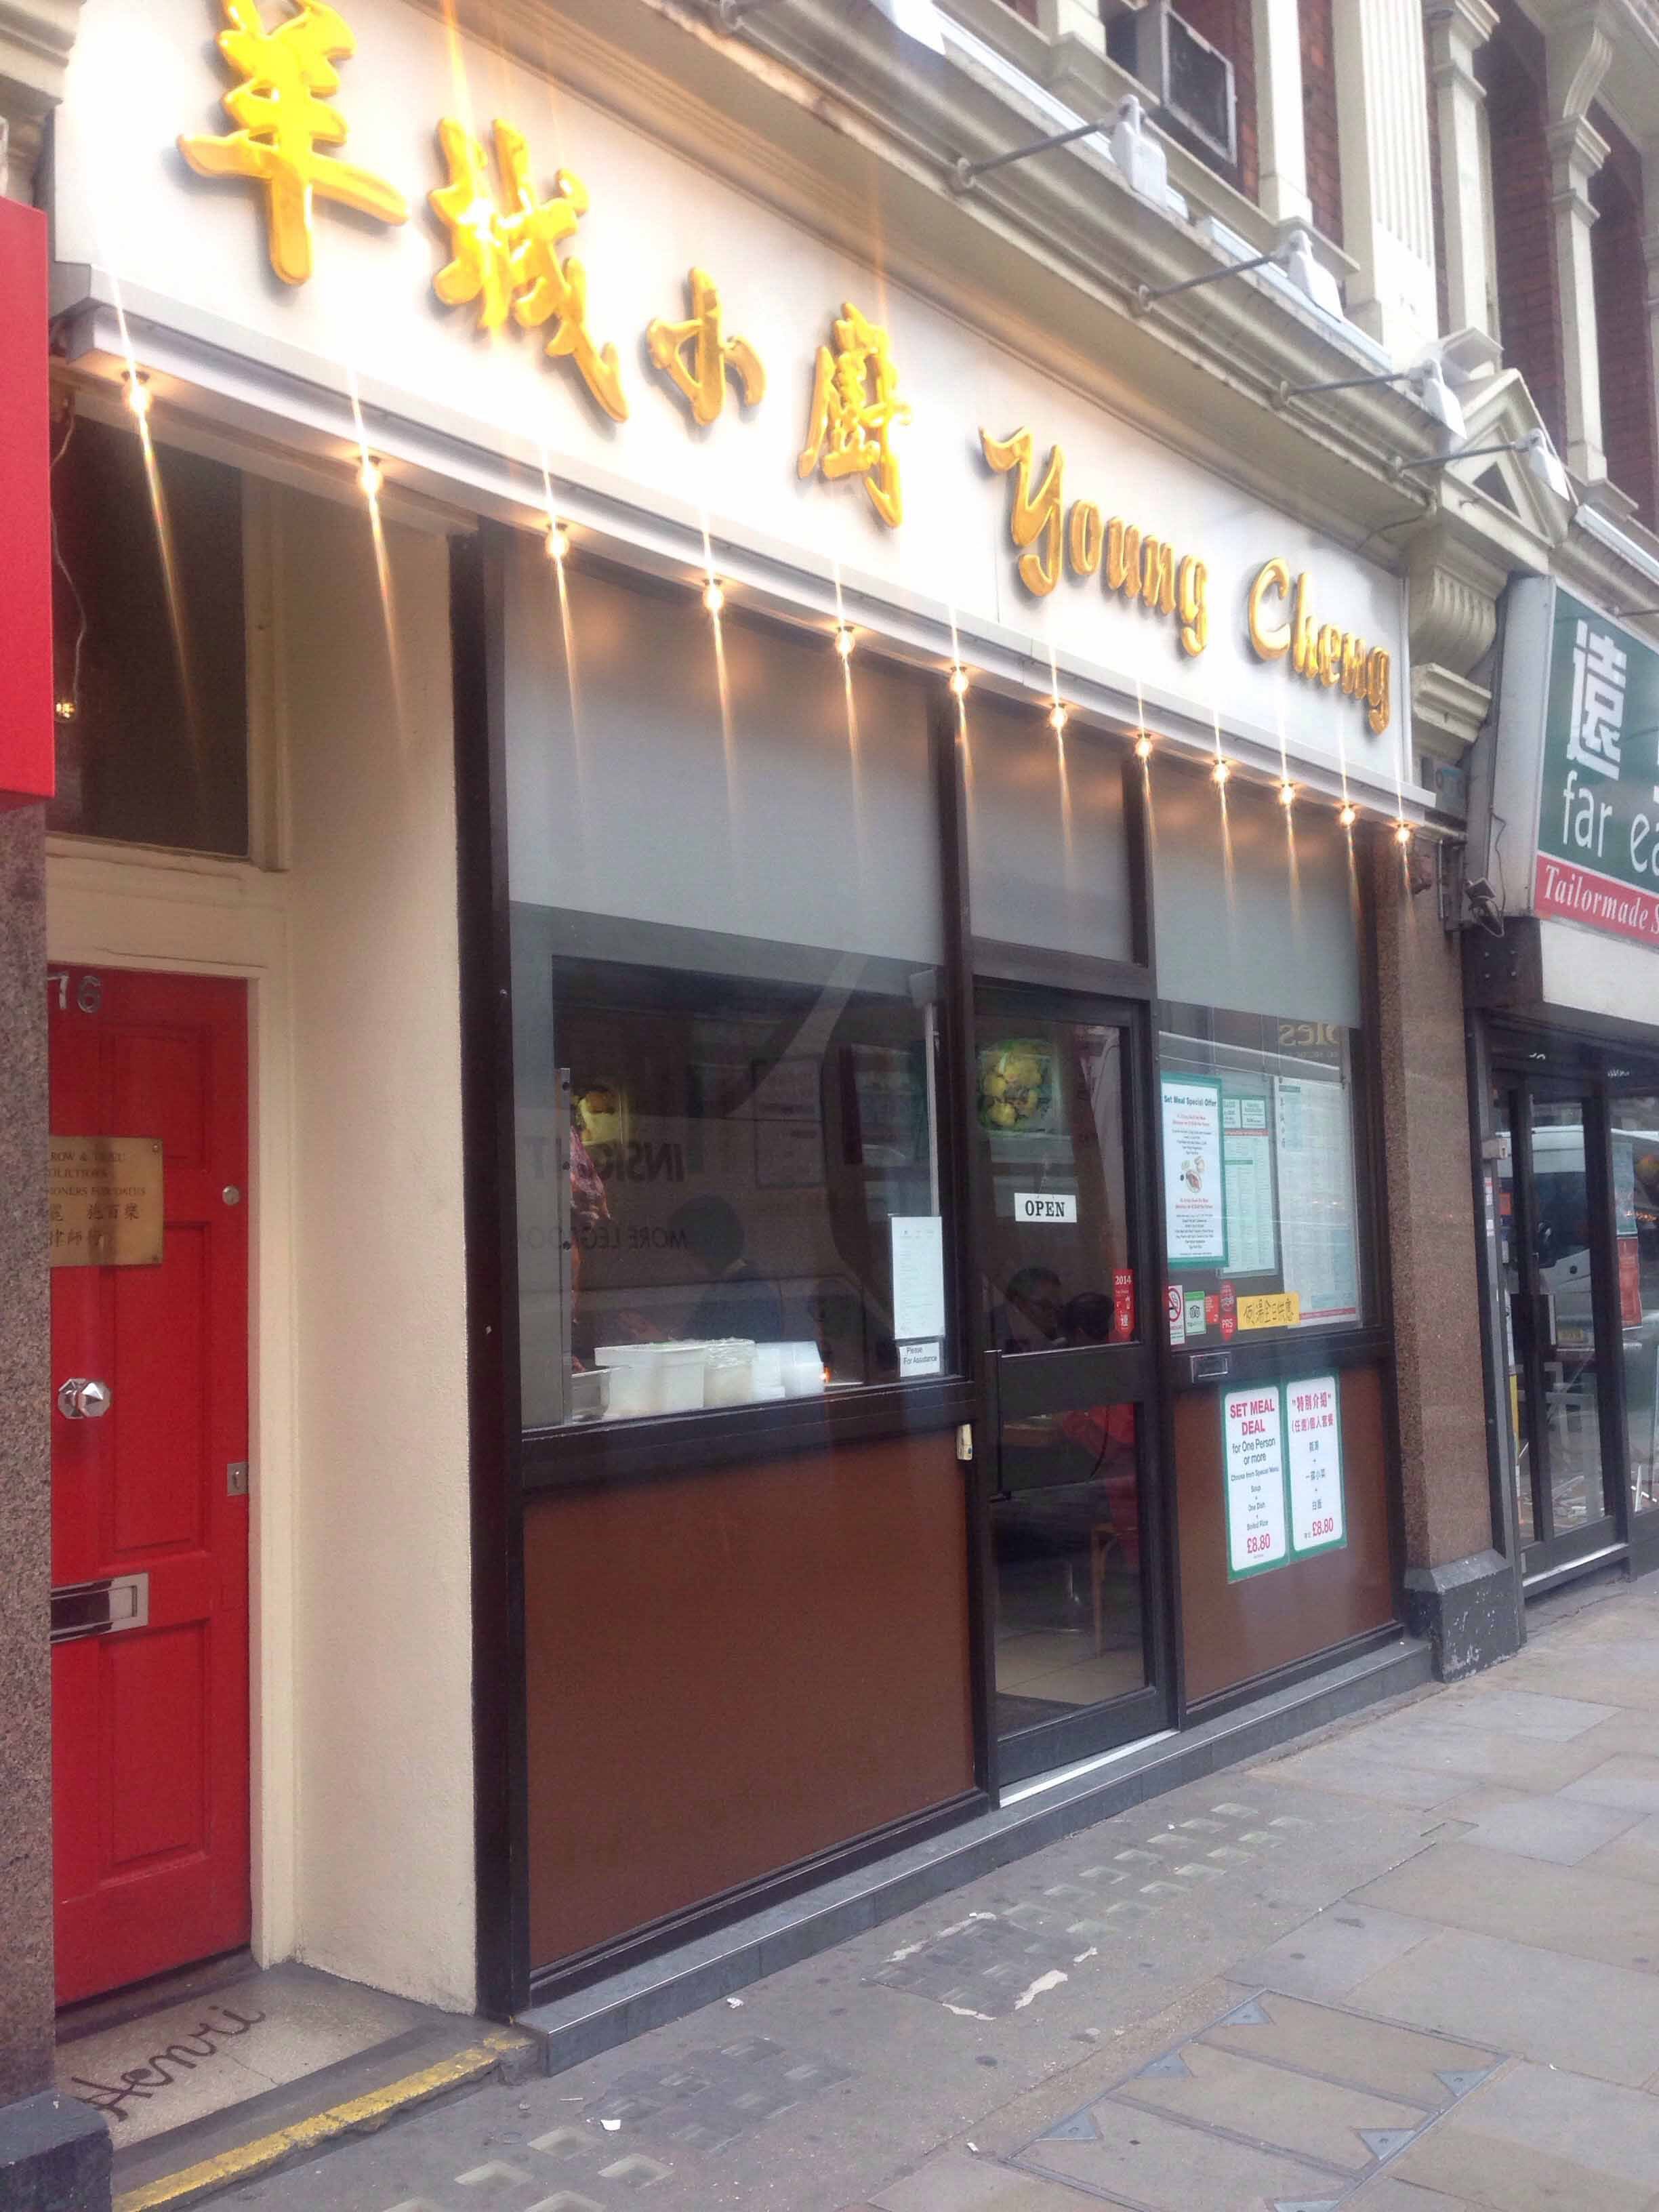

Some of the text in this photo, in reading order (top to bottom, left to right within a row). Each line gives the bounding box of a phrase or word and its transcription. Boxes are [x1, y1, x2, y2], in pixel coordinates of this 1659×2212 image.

[979, 425, 1391, 735] Young Cheng
[1563, 770, 1612, 857] far
[1544, 863, 1648, 930] Tailormade
[1187, 1097, 1204, 1107] Special
[1025, 1199, 1066, 1218] OPEN
[1115, 1275, 1132, 1286] 2014
[1230, 1399, 1275, 1418] SET MEAL
[1242, 1419, 1265, 1435] DEAL
[1232, 1438, 1275, 1454] for One Person
[1244, 1453, 1267, 1465] or more
[1312, 1517, 1334, 1536] £8.80
[1247, 1533, 1271, 1553] £8.80
